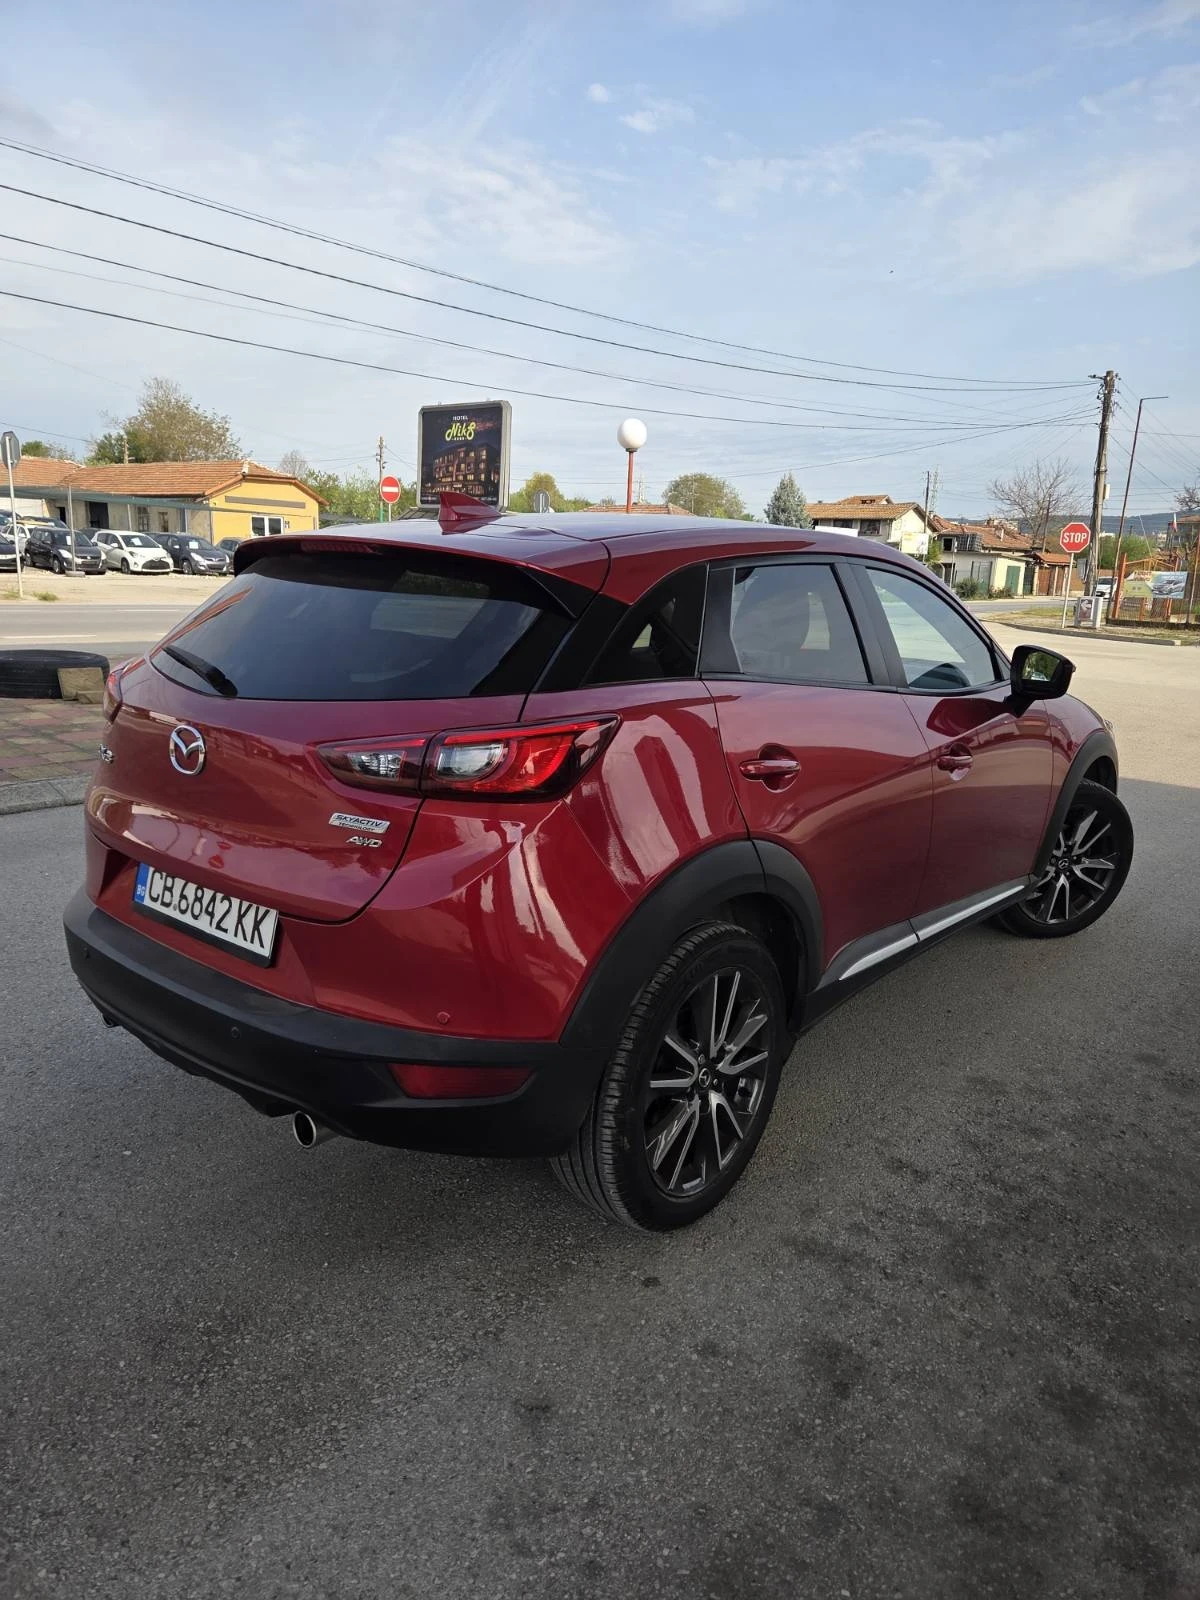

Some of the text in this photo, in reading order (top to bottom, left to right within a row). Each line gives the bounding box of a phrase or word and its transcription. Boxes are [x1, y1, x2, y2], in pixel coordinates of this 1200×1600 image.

[1063, 532, 1088, 544] STOP
[335, 814, 383, 827] SKYACTIV
[345, 836, 382, 848] AWD
